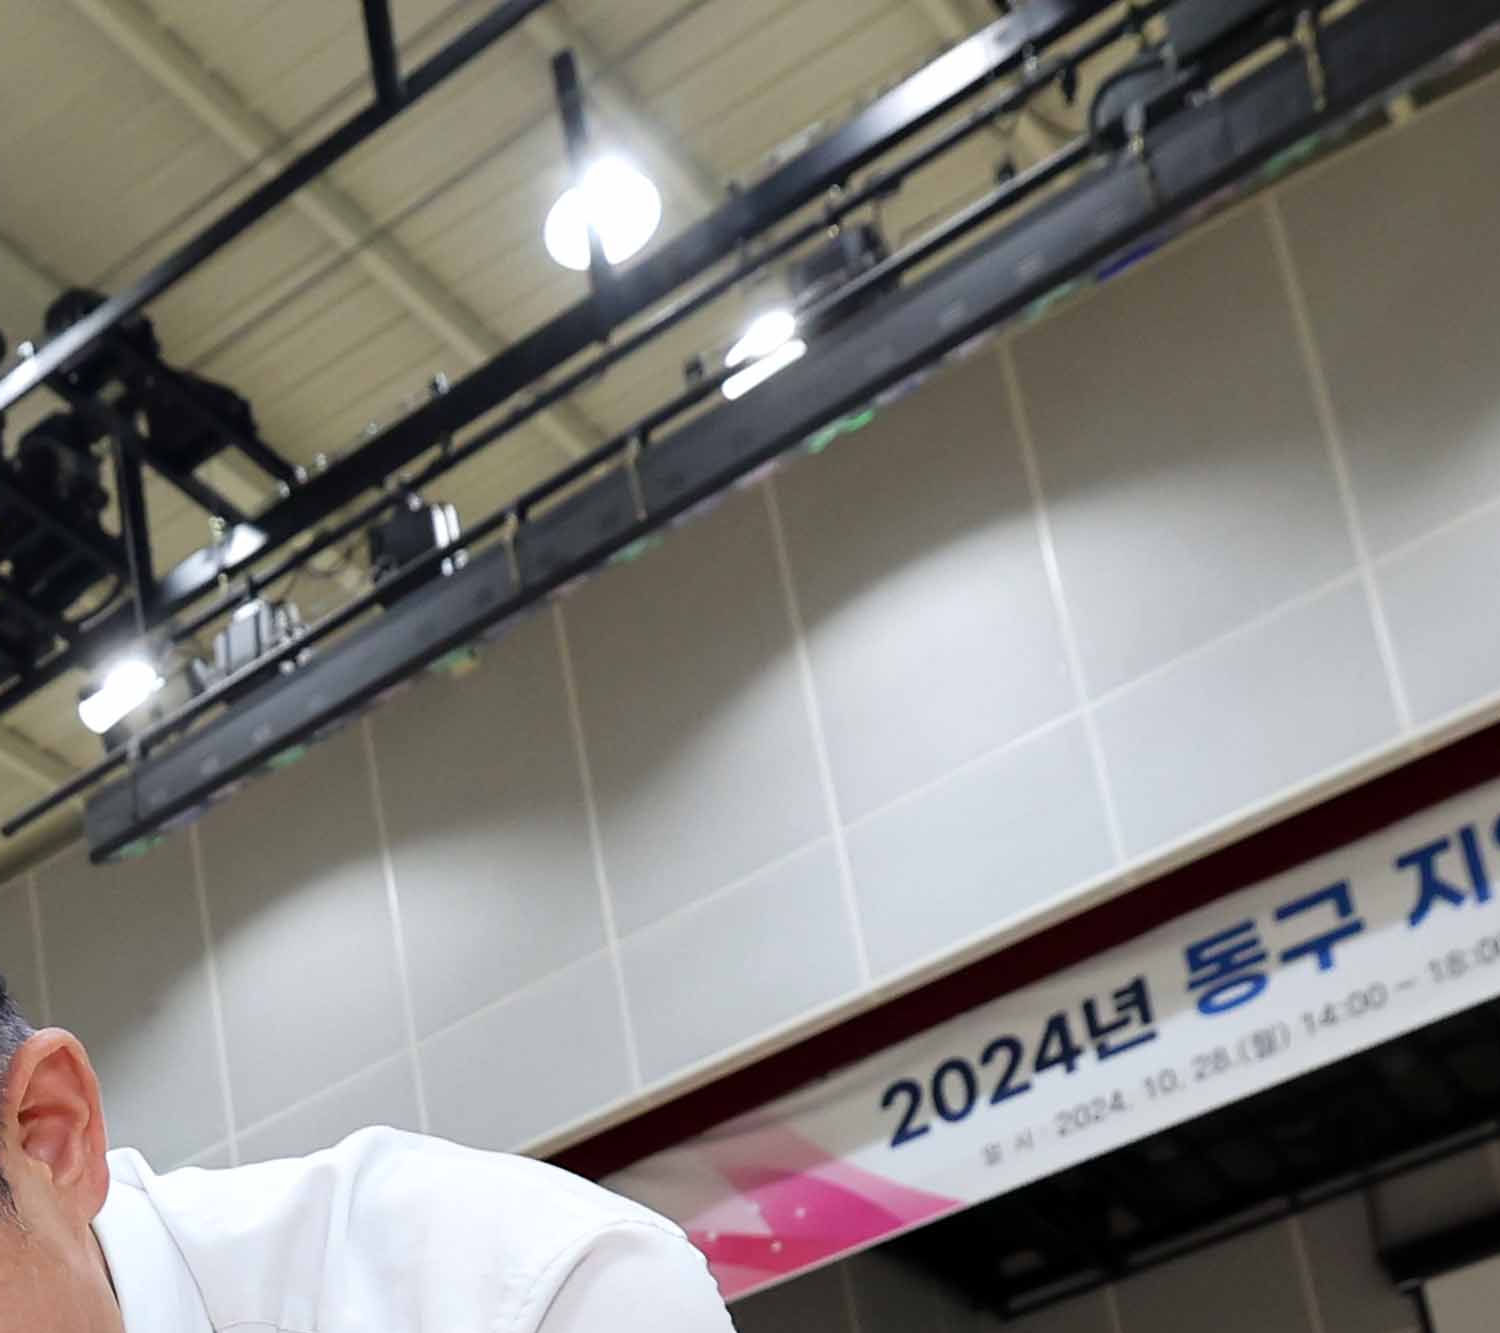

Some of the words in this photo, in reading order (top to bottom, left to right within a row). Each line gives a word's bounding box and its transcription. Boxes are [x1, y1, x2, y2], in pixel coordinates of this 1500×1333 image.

[881, 974, 1158, 1149] 2024년
[1183, 878, 1367, 1017] 동구
[1301, 981, 1389, 1037] 14:00
